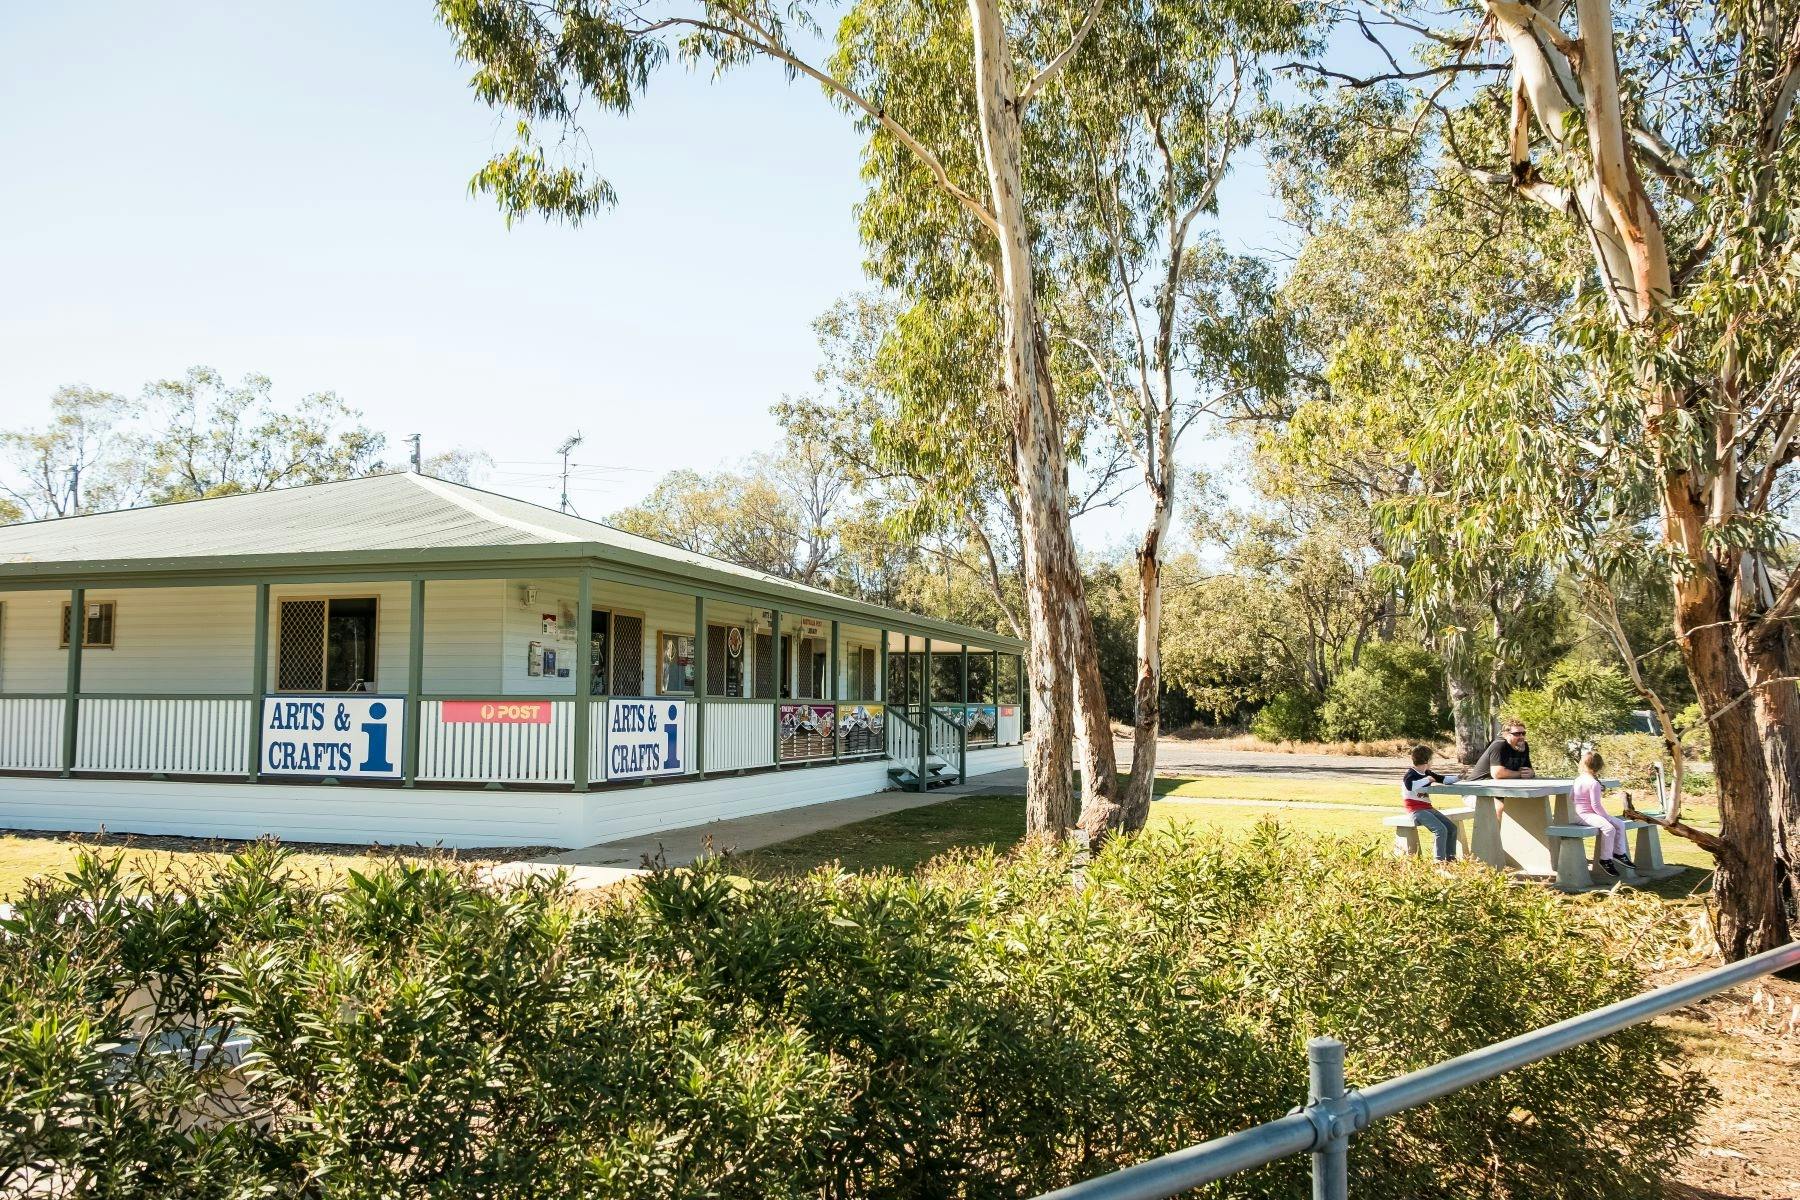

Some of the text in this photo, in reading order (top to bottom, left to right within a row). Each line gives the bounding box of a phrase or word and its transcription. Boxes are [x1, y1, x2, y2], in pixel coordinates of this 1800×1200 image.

[269, 702, 351, 732] ARTS &
[497, 705, 541, 720] POST
[612, 704, 657, 733] ARTS &
[359, 702, 394, 772] i
[663, 704, 681, 770] i
[268, 741, 352, 772] CRAFTS
[612, 742, 660, 774] CRAFTS
